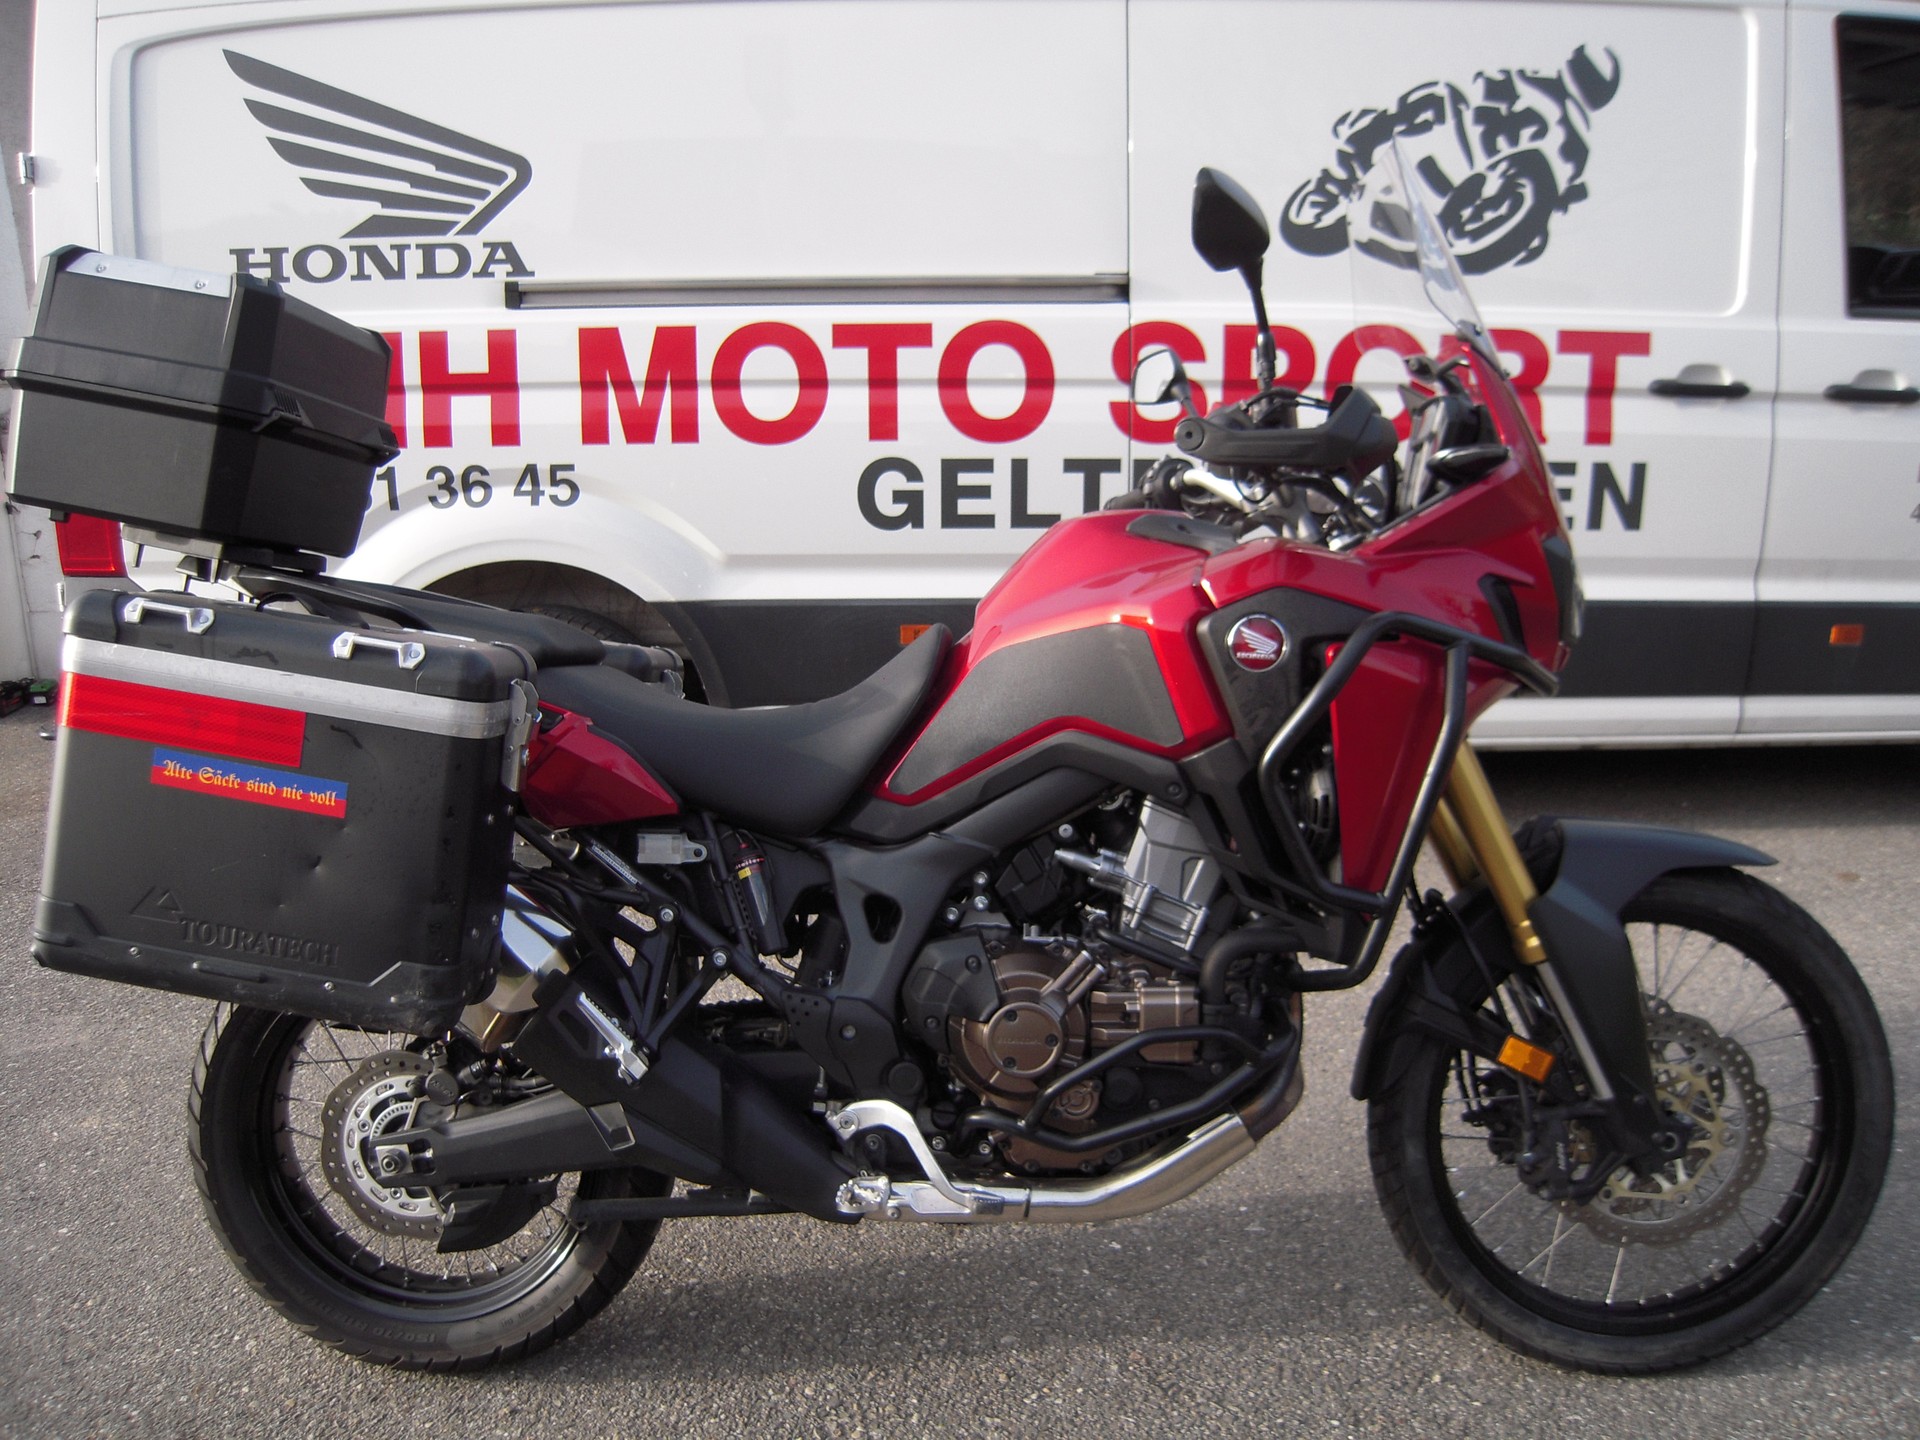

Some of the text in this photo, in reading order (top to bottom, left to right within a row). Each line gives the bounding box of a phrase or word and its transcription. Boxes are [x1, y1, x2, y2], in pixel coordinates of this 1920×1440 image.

[229, 241, 535, 284] HONDA
[577, 319, 1056, 446] MOTO
[1108, 320, 1652, 447] SPORT
[365, 463, 581, 512] 1 36 45
[162, 759, 337, 807] Alte Säcke sind nie voll
[180, 918, 340, 968] TOURATECH
